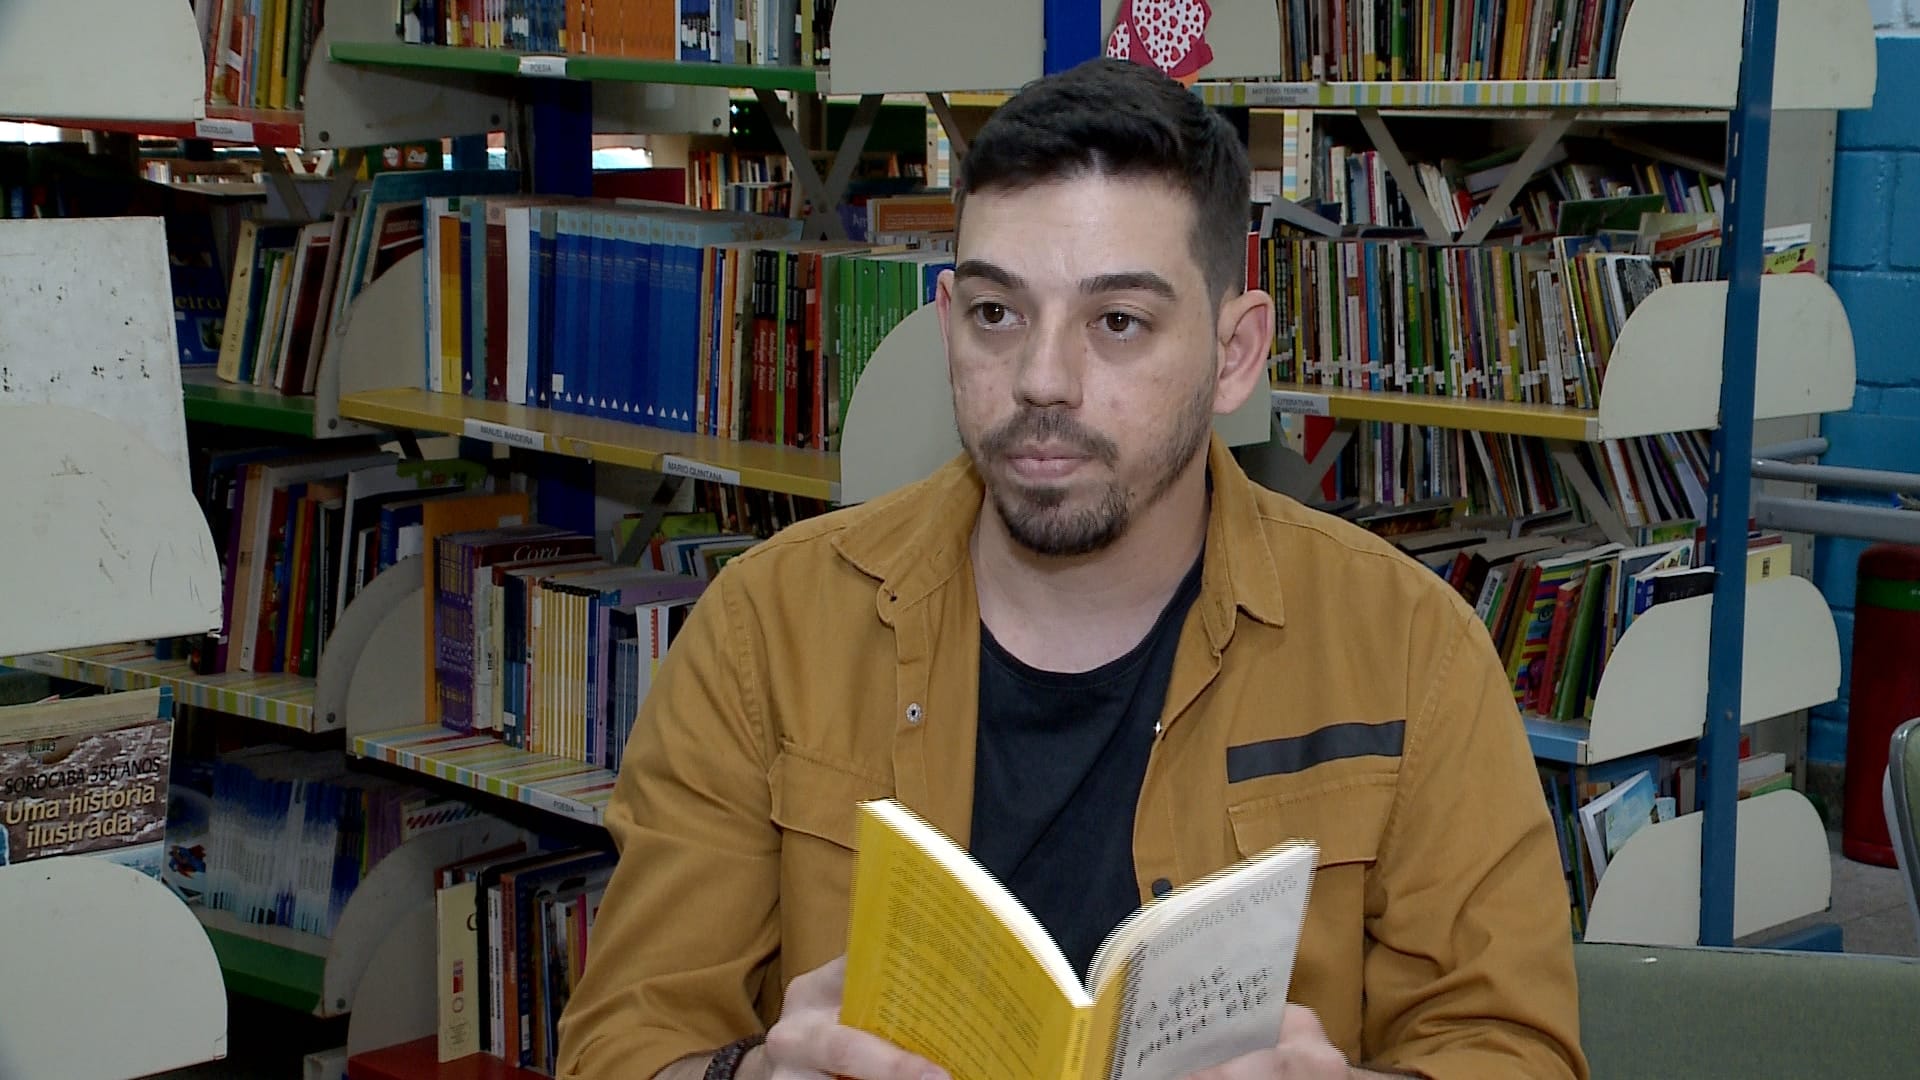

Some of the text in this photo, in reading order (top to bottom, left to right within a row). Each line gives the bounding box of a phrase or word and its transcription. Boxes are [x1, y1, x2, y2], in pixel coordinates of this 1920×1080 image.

[529, 63, 552, 73] POESIA
[503, 430, 534, 445] BANDEIRA
[689, 466, 722, 482] QUINTANA
[513, 544, 561, 561] Cora
[4, 756, 161, 795] SOROCABA 350 ANOS
[5, 798, 60, 826] Uma
[26, 811, 132, 848] ilustrada
[1159, 965, 1273, 1032] escrevo
[1169, 965, 1232, 1009] que
[1136, 1013, 1209, 1068] para
[1225, 985, 1271, 1018] ele
